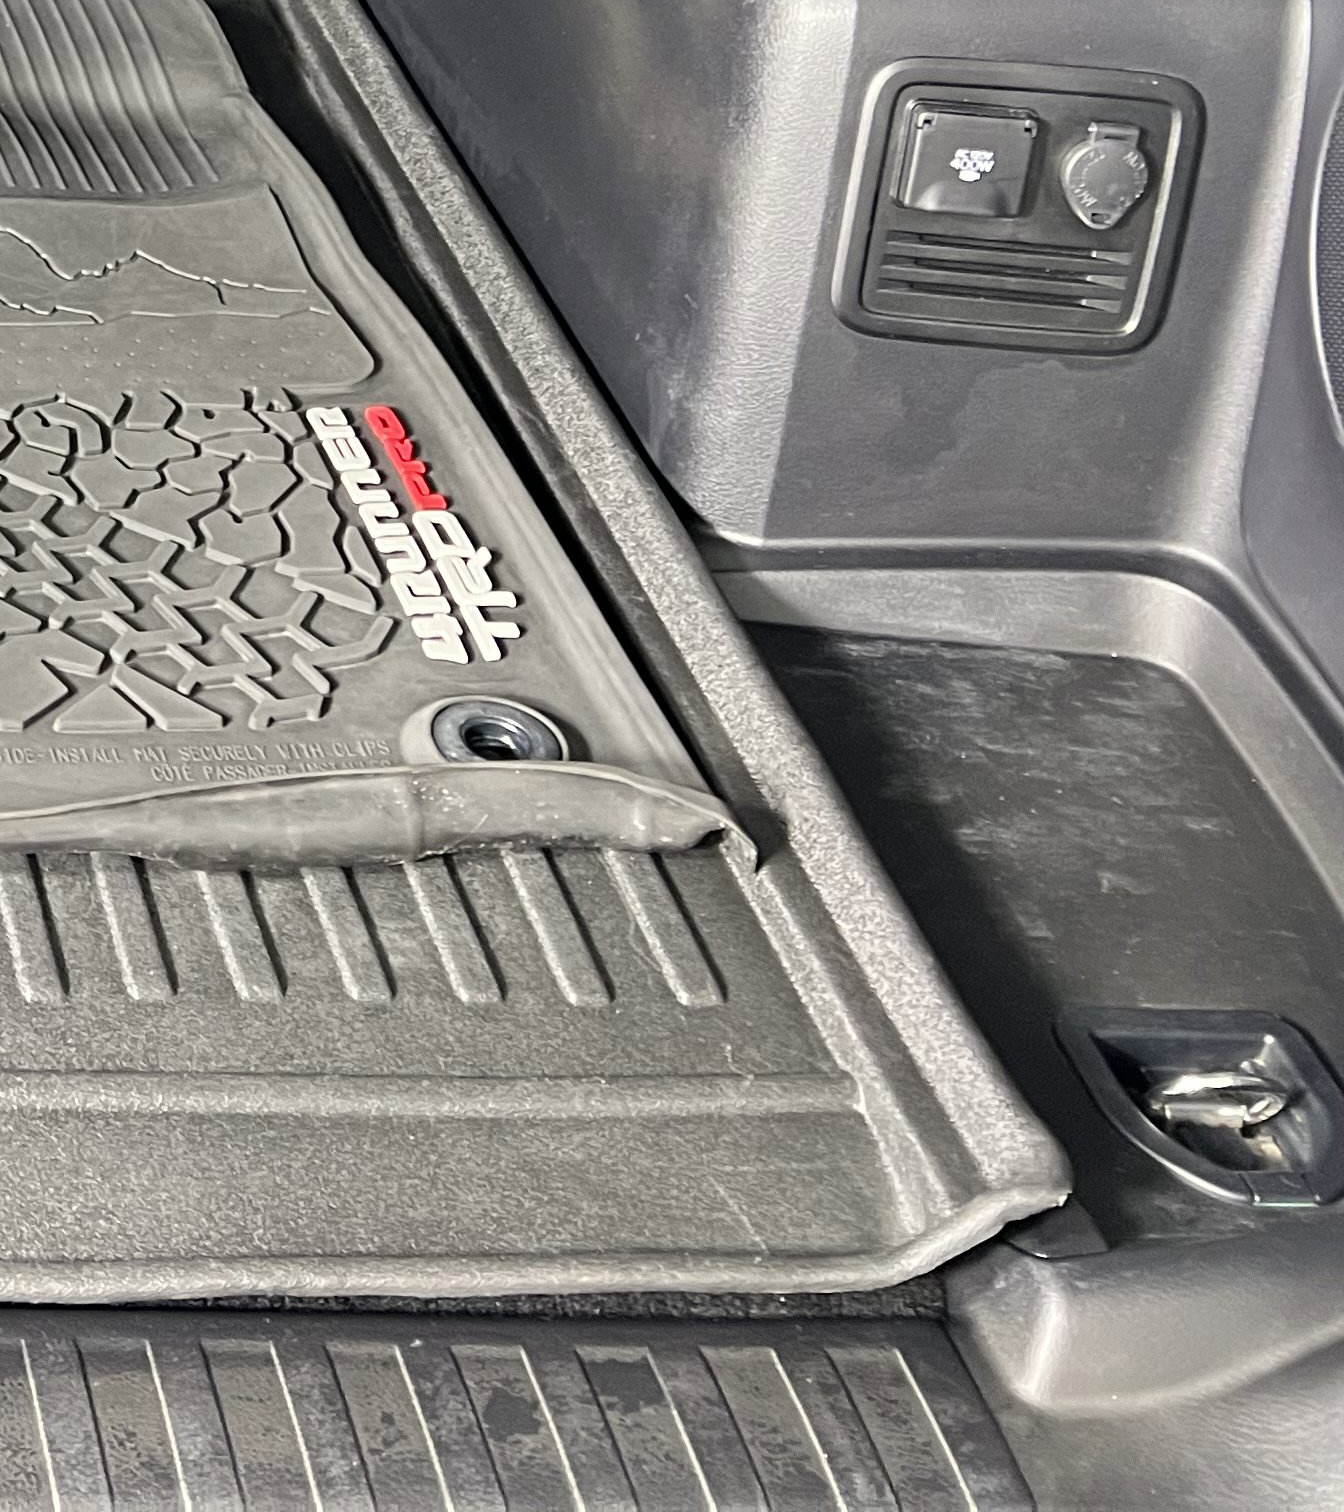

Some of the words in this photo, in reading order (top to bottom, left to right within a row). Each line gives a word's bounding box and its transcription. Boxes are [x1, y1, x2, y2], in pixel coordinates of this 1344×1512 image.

[949, 158, 995, 173] 400W
[178, 742, 269, 763] SECURELY
[332, 738, 392, 759] CLIPS
